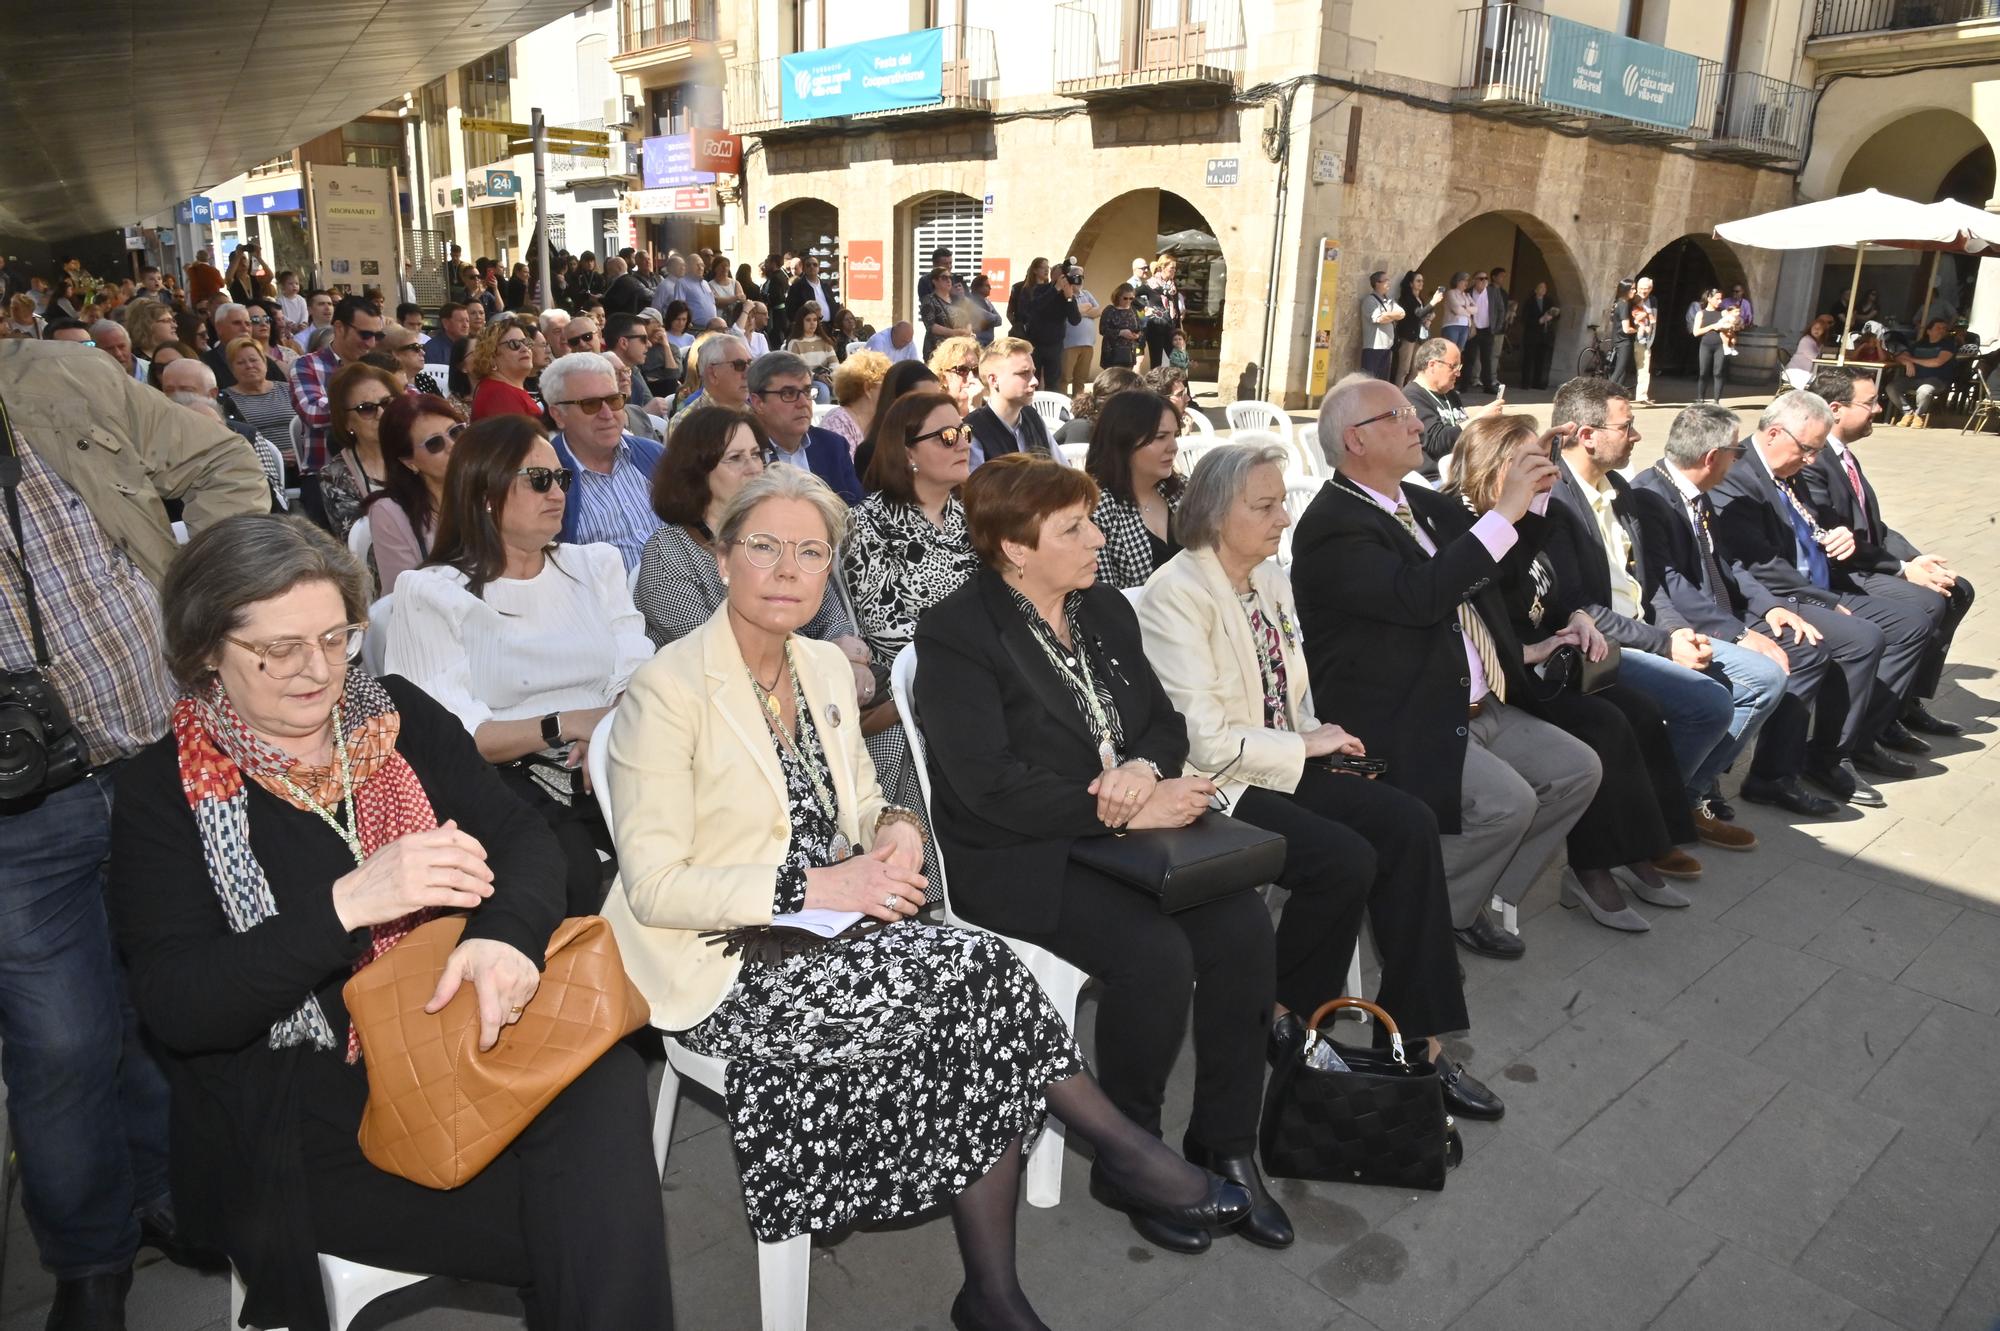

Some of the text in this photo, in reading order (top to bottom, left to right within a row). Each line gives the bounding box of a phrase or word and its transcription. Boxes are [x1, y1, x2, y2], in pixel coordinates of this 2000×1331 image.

[874, 53, 912, 69] Festa del
[1573, 76, 1602, 94] vila-real
[1640, 77, 1675, 94] caixa rural
[1638, 89, 1664, 103] vila-real
[704, 140, 732, 157] FoM
[1217, 160, 1237, 168] PLAÇA
[1207, 174, 1237, 184] MAJOR
